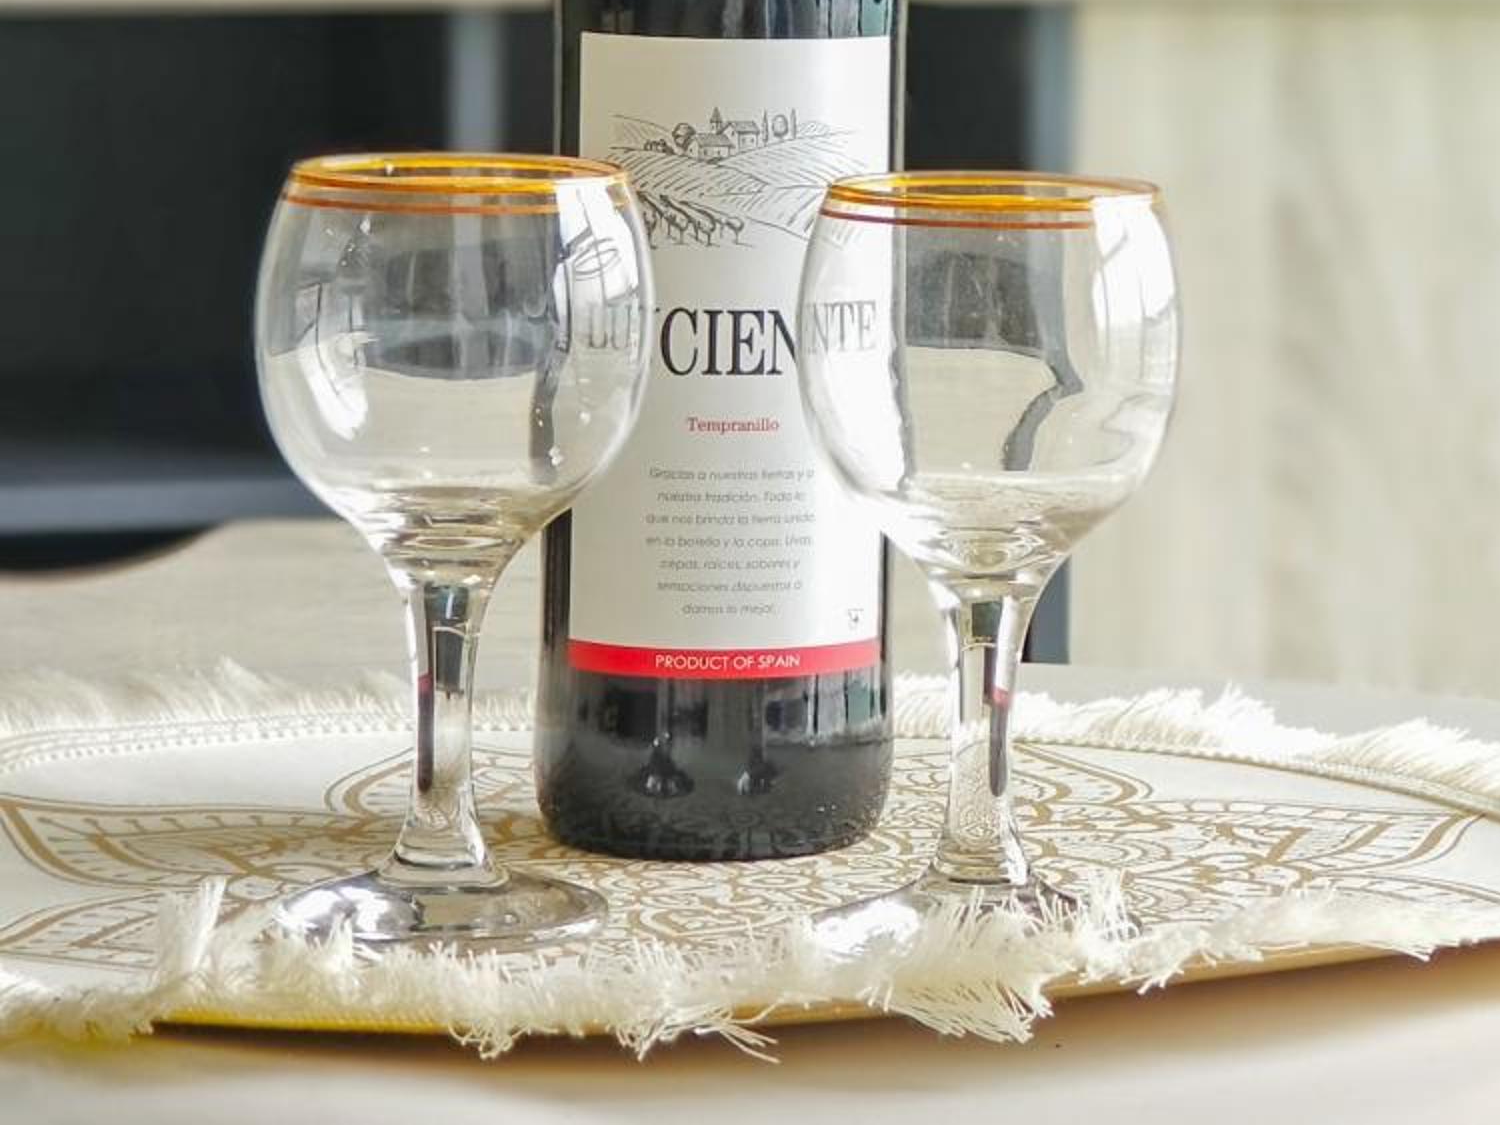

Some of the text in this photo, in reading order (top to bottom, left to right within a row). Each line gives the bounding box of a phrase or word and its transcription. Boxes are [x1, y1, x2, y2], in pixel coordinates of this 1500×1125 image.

[687, 416, 780, 435] Tempranillo
[655, 654, 801, 671] PRODUCT OF SPAIN
